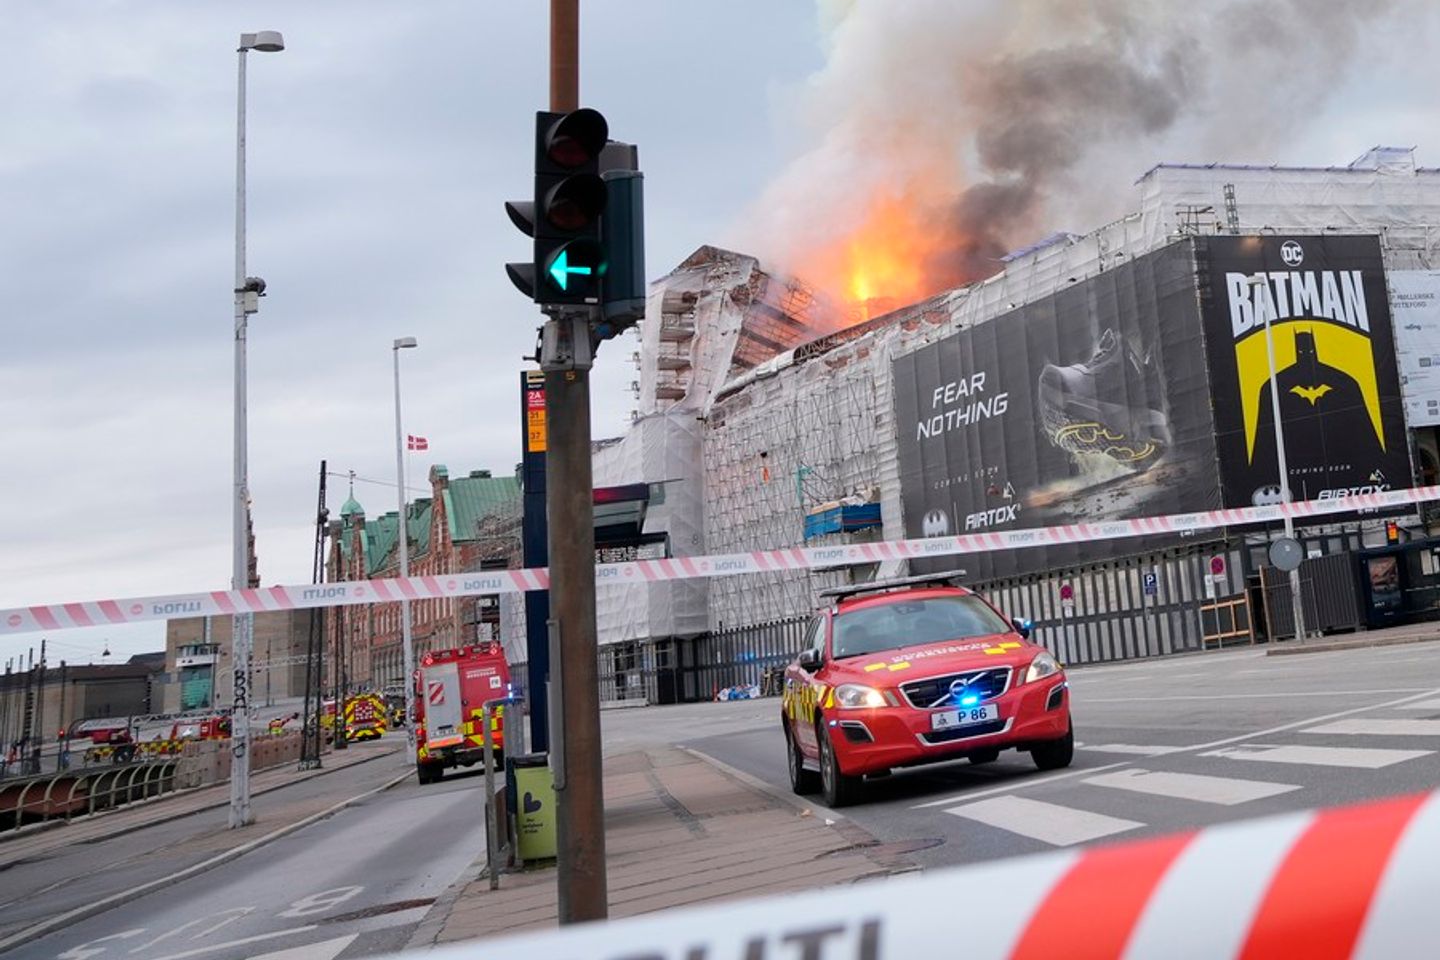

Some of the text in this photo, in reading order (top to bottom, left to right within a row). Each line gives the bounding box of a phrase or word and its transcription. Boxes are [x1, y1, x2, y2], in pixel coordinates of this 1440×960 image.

[1283, 245, 1303, 261] DC
[1226, 271, 1370, 338] BATMAN
[933, 372, 985, 408] FEAR
[917, 393, 1008, 441] NOTHING
[1290, 464, 1351, 475] COMING SOON
[958, 708, 987, 723] P 86
